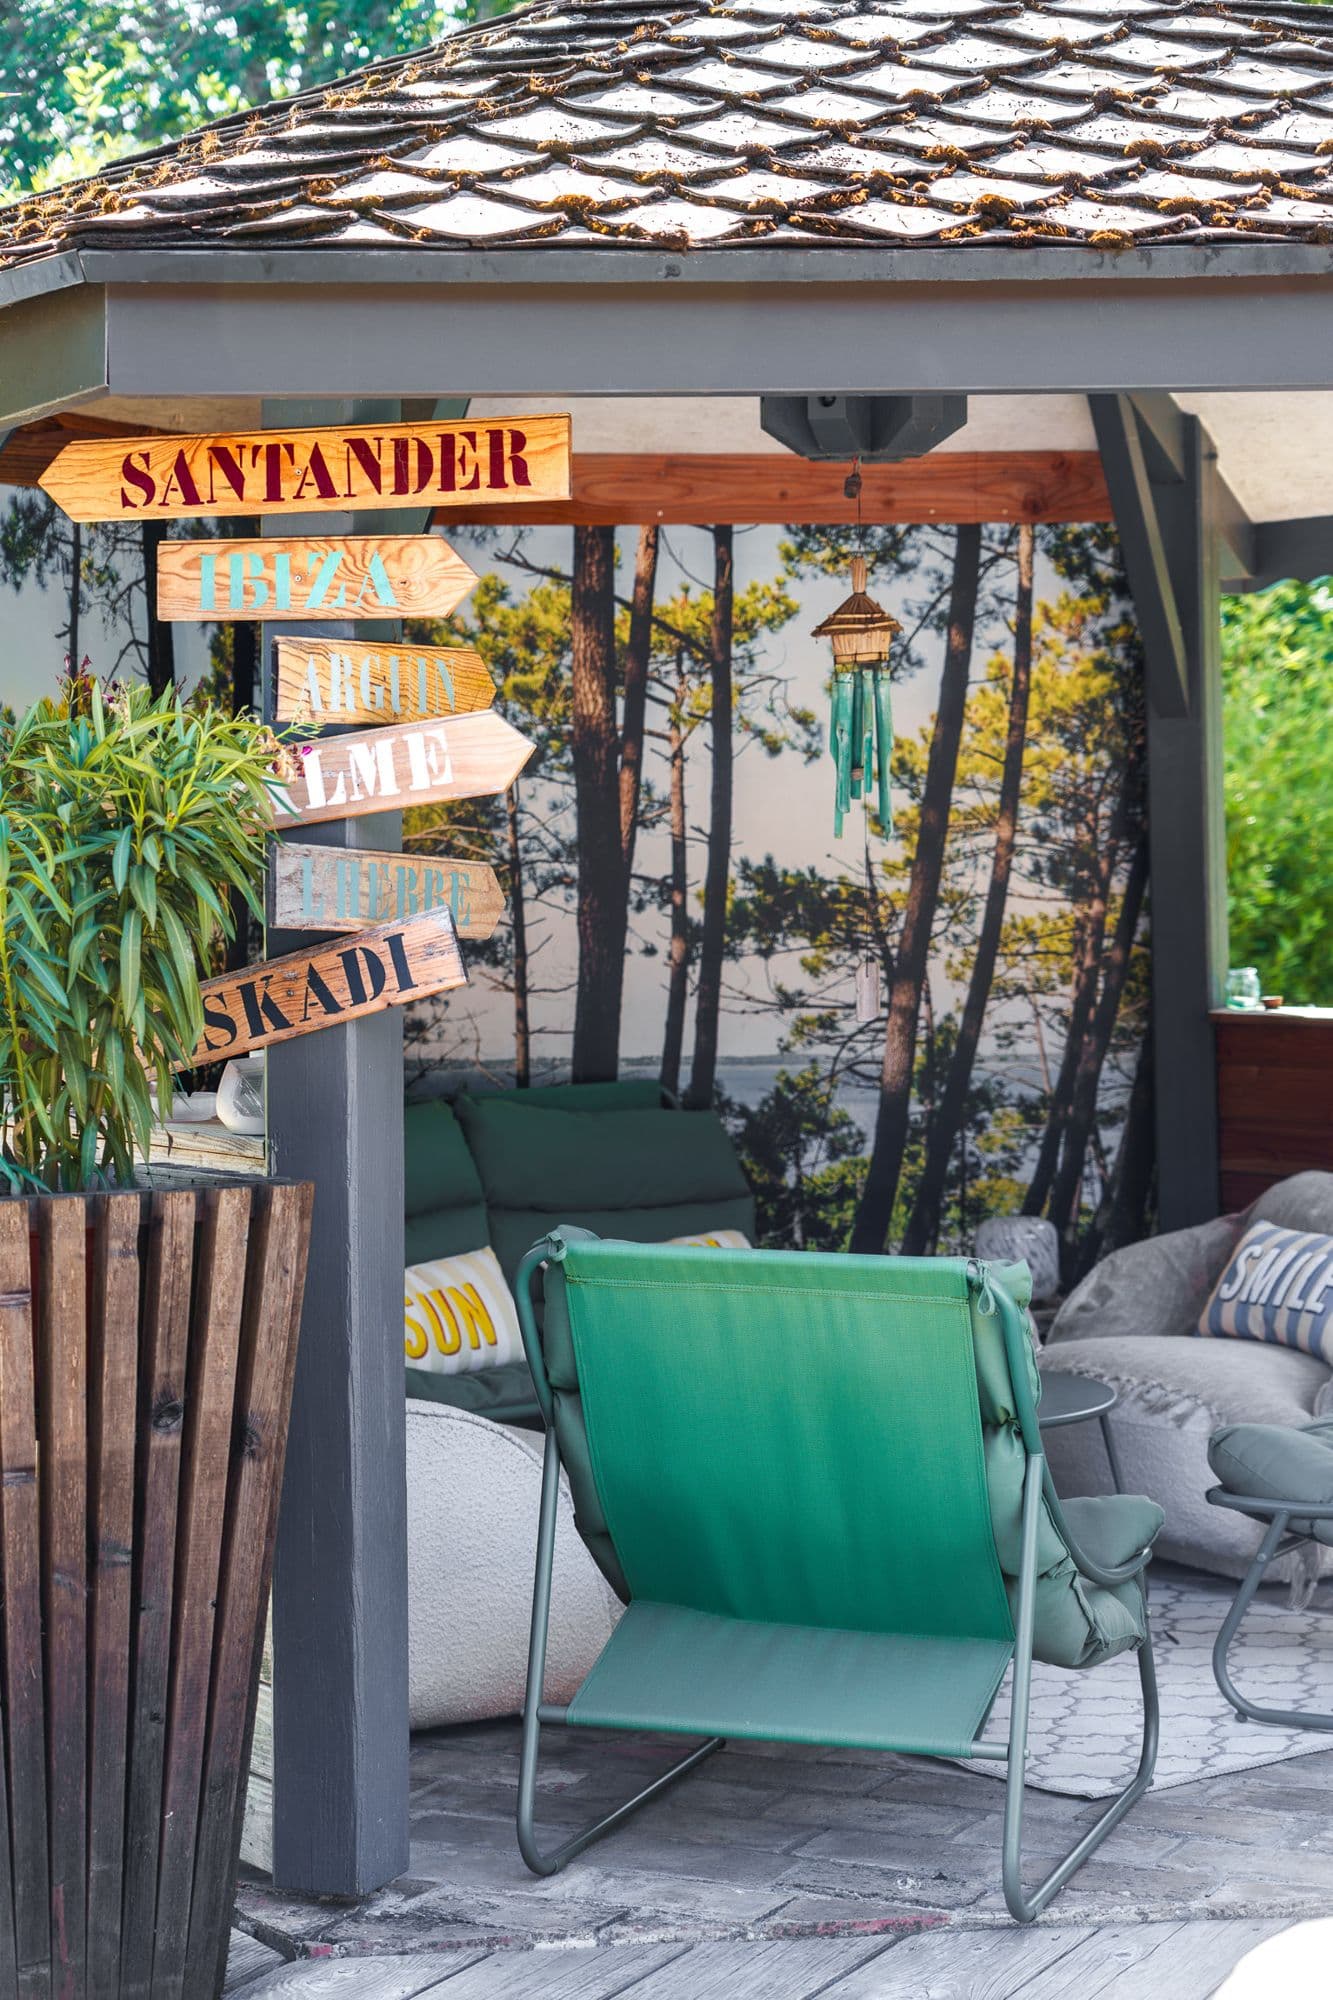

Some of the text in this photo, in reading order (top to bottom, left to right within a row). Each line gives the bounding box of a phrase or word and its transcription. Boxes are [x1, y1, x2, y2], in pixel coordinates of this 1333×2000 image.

[120, 428, 531, 509] SANTANDER
[200, 549, 399, 610] IBIZA
[297, 652, 456, 715] ARGUIN
[150, 933, 419, 1064] SKADI
[1218, 1245, 1333, 1314] SMILE
[405, 1282, 498, 1360] SUN
